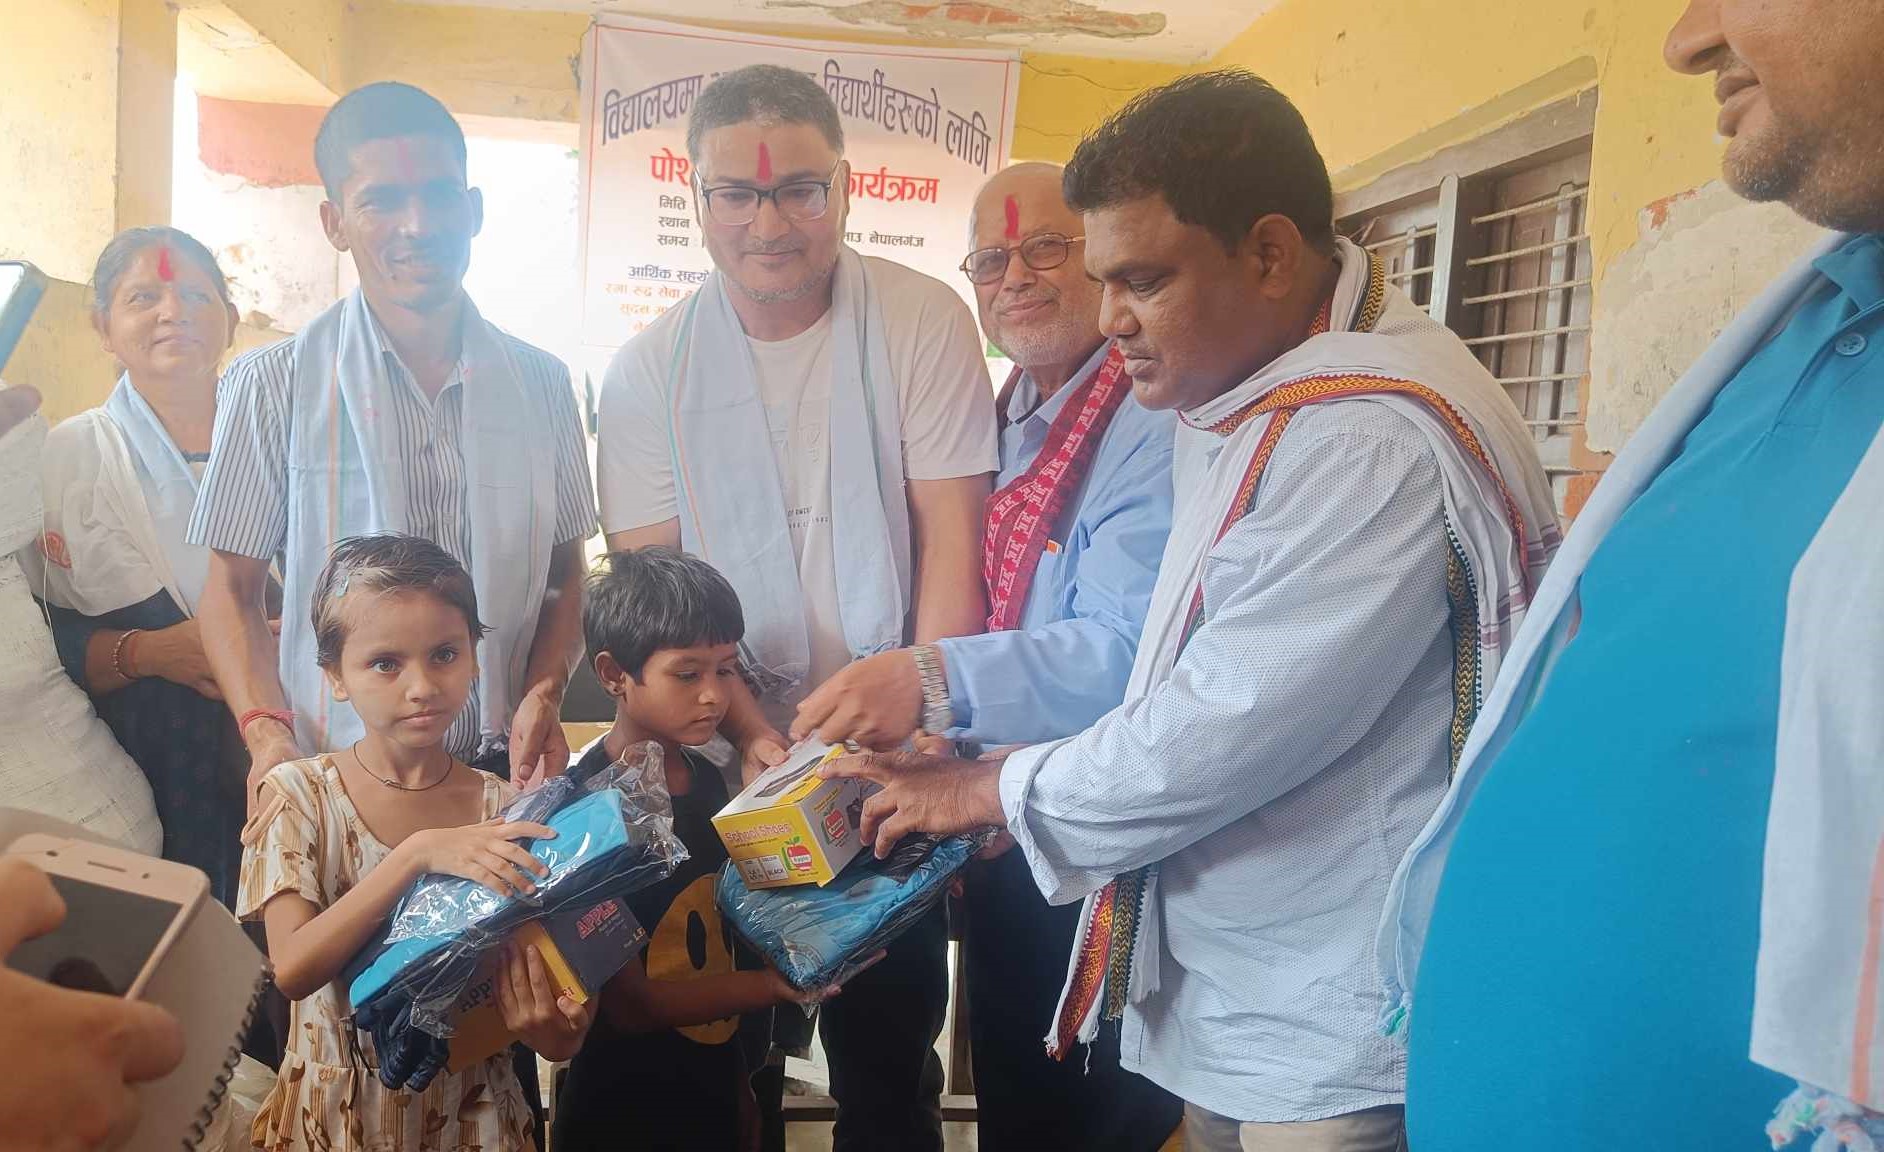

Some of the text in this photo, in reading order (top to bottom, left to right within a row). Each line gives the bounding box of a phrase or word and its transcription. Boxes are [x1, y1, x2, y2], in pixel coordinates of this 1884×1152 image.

[946, 111, 991, 175] लागि
[650, 147, 689, 186] पोश
[659, 194, 687, 210] मिति
[658, 216, 691, 229] स्थान
[657, 234, 690, 247] समय
[628, 264, 672, 280] आर्थिक
[725, 823, 791, 842] School Shoes
[576, 900, 619, 940] APPLE
